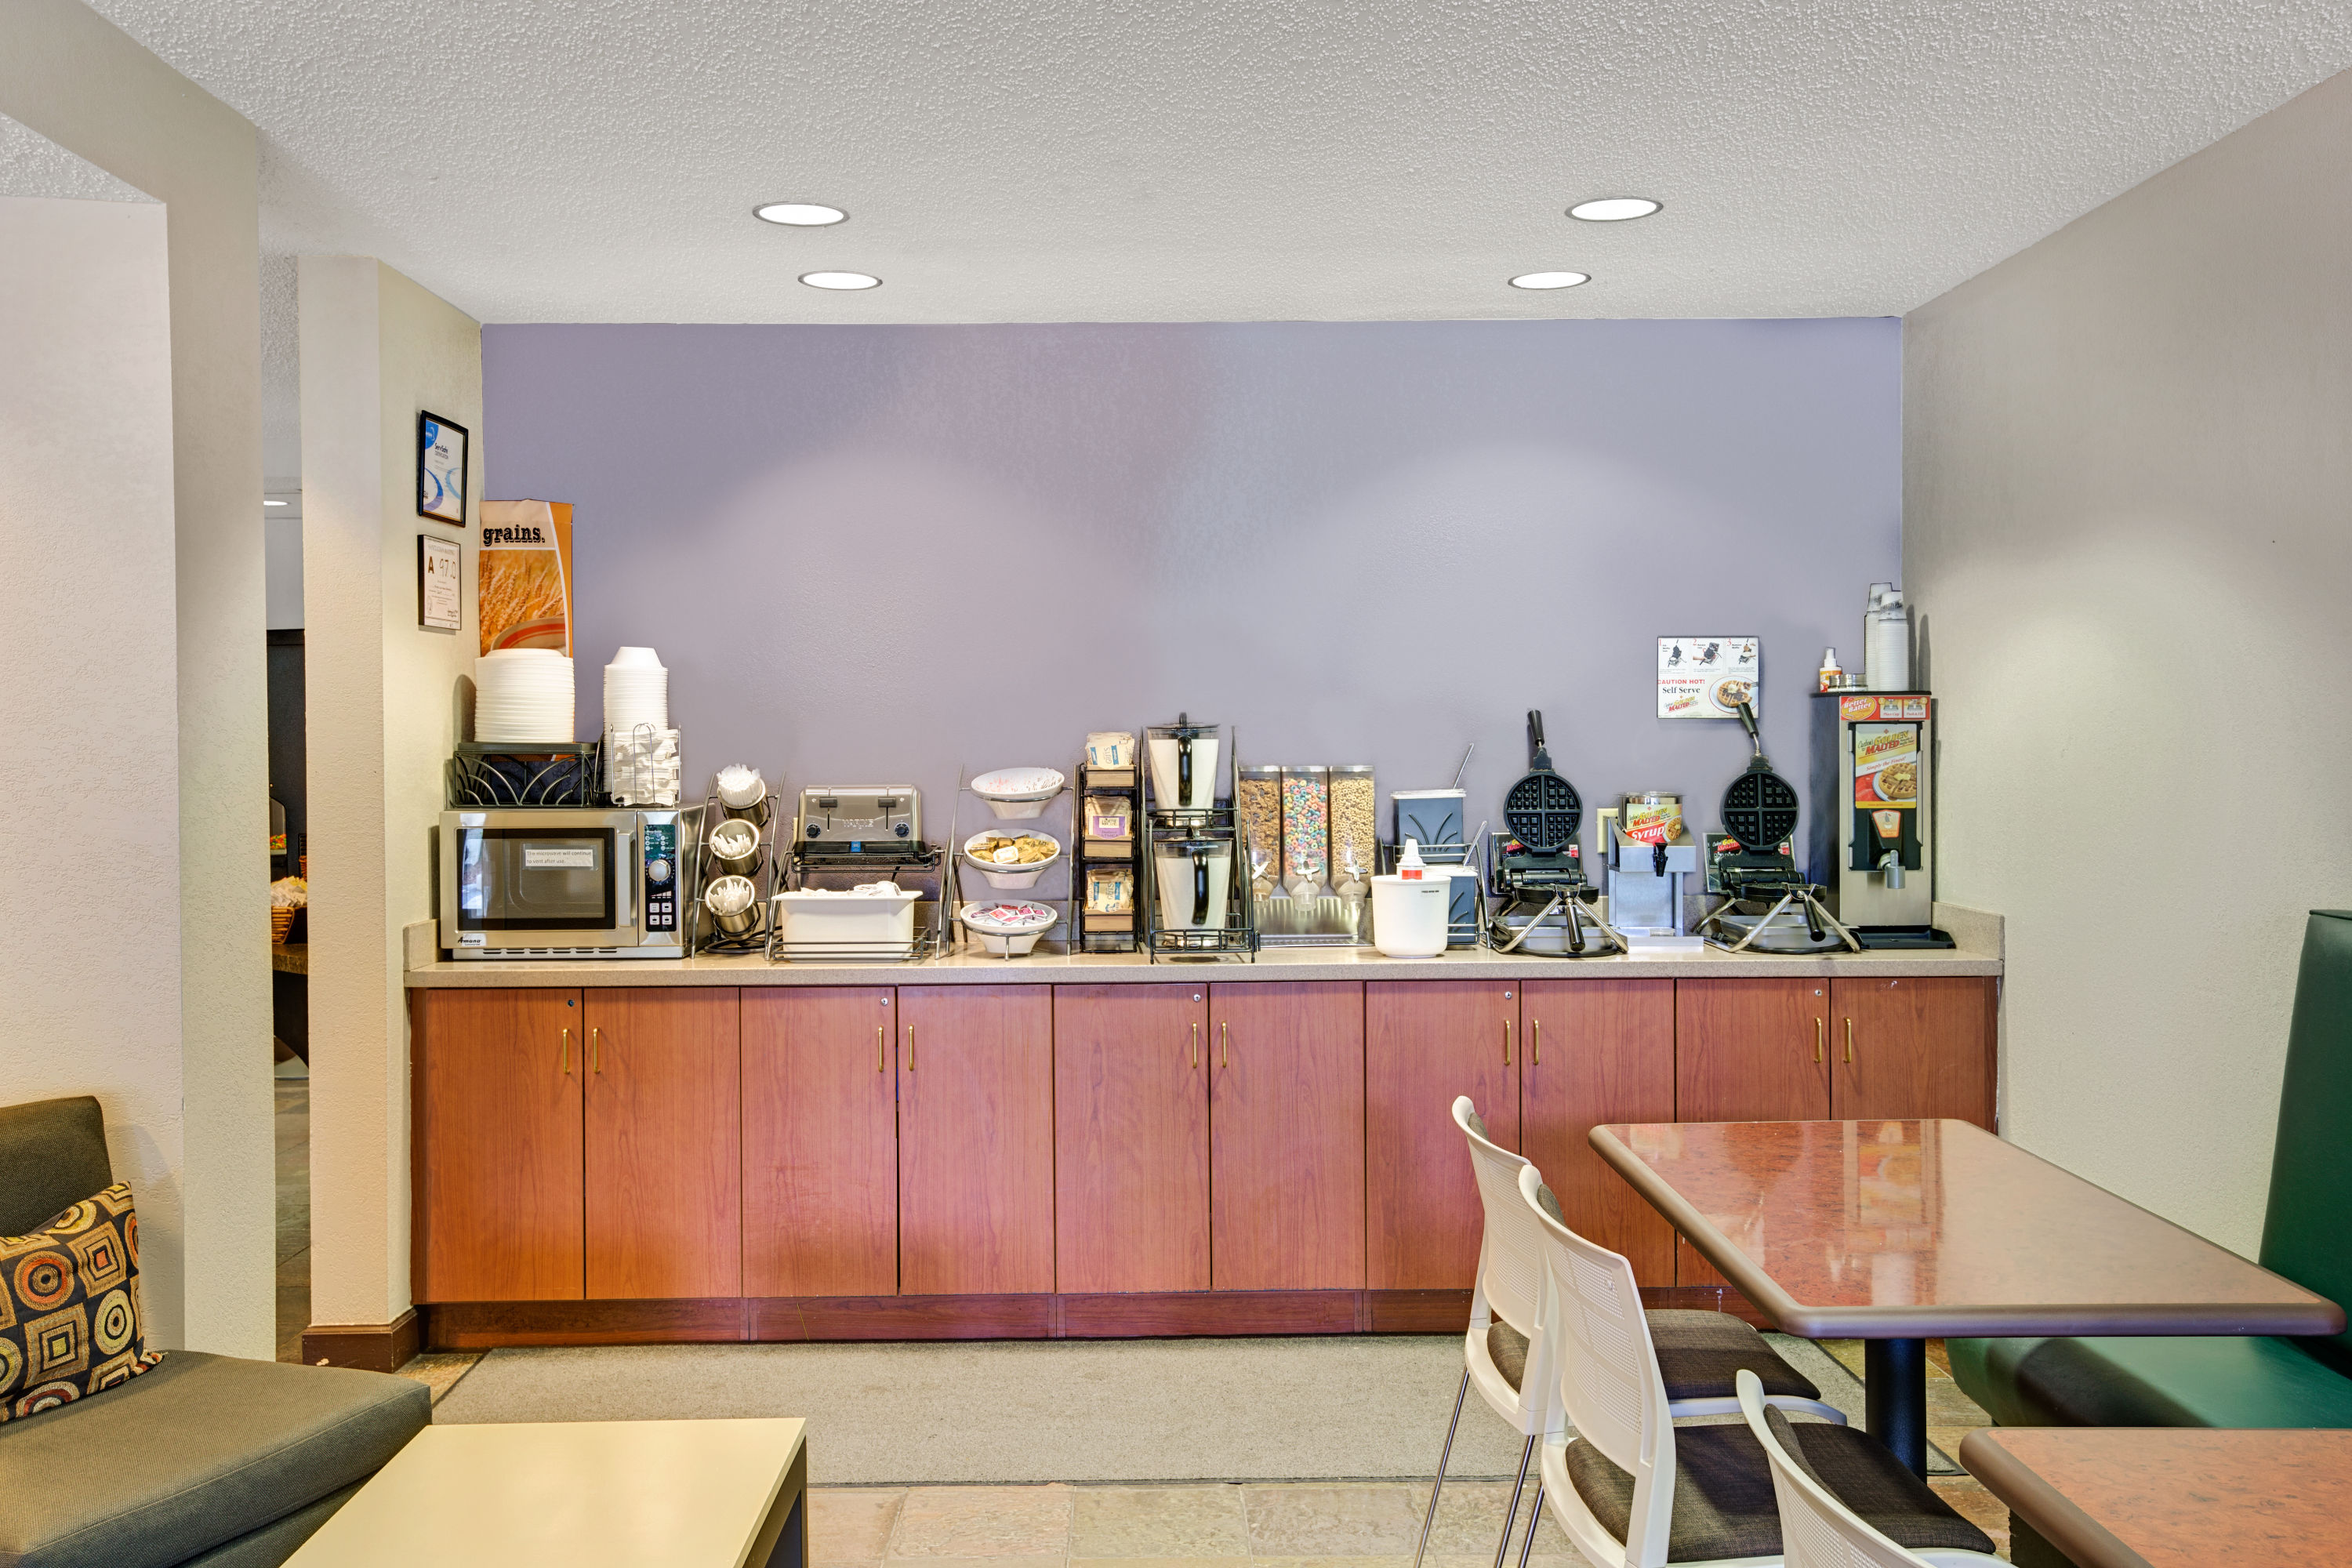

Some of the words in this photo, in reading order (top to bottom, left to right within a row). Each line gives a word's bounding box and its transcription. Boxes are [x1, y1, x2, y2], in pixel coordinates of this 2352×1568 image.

[483, 524, 546, 546] grains.
[428, 556, 434, 574] A
[1844, 698, 1867, 709] Better
[1848, 702, 1872, 713] Batter
[1875, 730, 1908, 746] GOLDEN
[1865, 740, 1900, 755] MALTED
[1633, 815, 1661, 826] MALTED
[1632, 826, 1665, 840] Syrup
